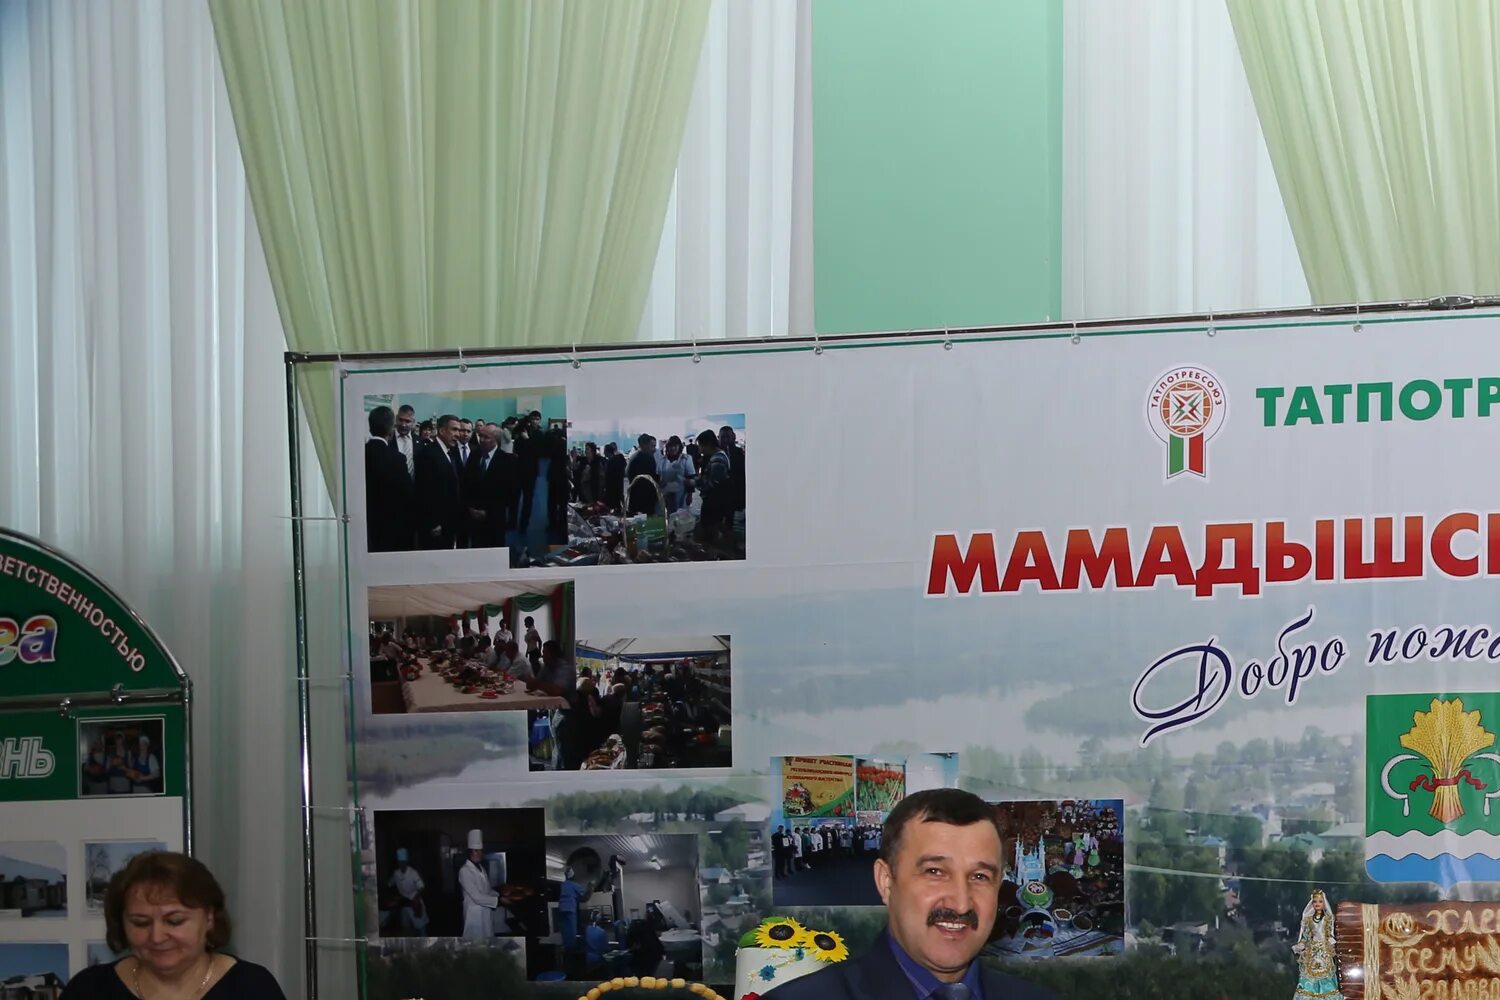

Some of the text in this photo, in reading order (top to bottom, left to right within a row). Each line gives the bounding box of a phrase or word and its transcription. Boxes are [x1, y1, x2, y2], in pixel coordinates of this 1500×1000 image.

[1152, 371, 1222, 408] ТАТПОТРЕБСОЮЗ
[0, 554, 146, 672] ЕТСТВЕННОСТЬЮ
[1132, 606, 1346, 744] Добро
[0, 736, 56, 779] НЬ
